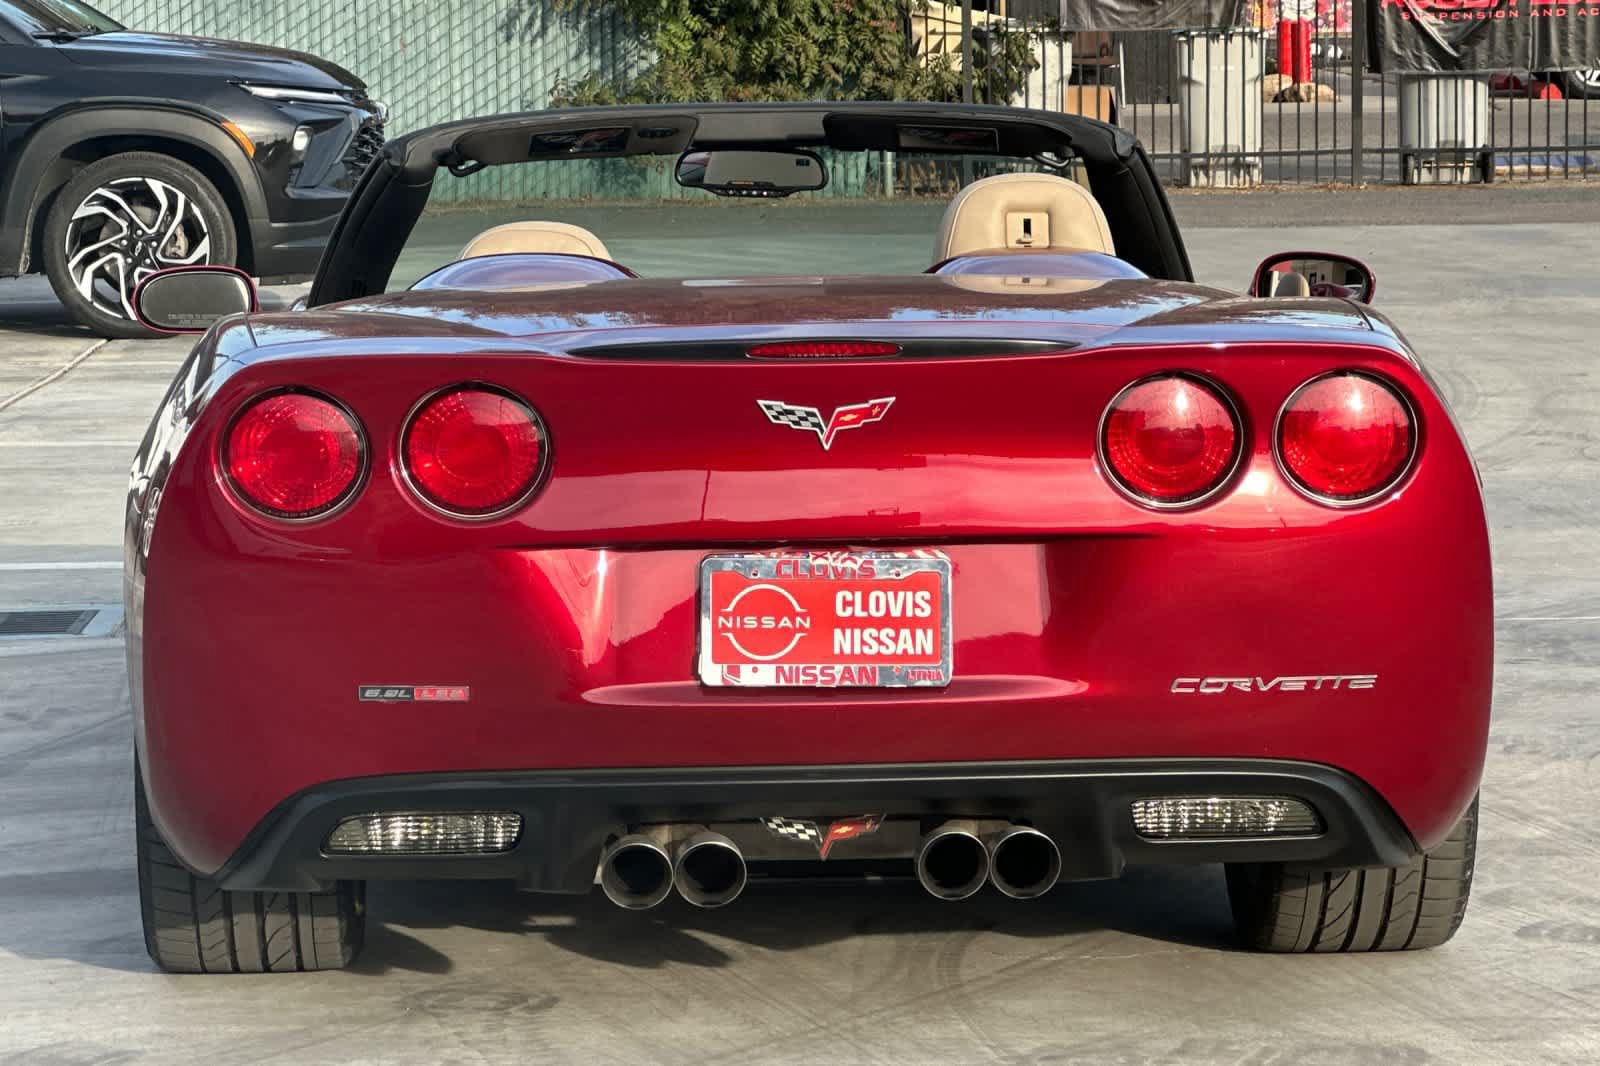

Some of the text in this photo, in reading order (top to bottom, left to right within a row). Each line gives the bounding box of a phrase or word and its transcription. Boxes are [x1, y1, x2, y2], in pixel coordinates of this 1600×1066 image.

[1401, 10, 1519, 20] SPENSION
[1530, 8, 1566, 17] AND
[775, 559, 876, 579] CLOVIS
[835, 590, 932, 618] CLOVIS
[718, 616, 811, 629] NISSAN
[833, 628, 934, 656] NISSAN
[775, 665, 879, 686] NISSAN
[1171, 674, 1378, 693] CORVETTE
